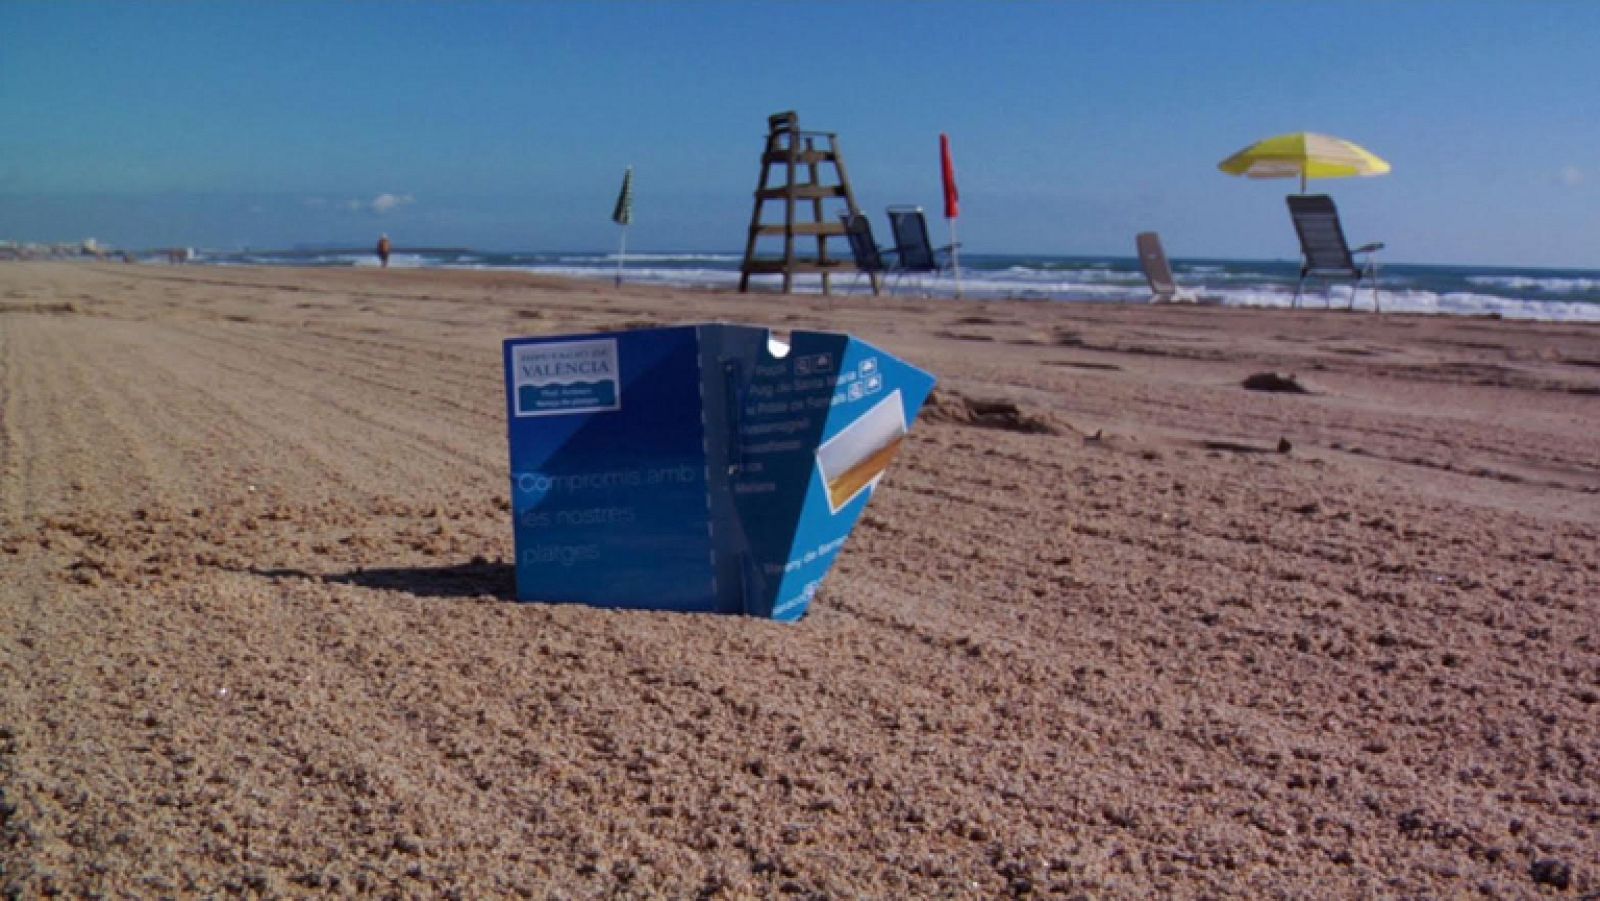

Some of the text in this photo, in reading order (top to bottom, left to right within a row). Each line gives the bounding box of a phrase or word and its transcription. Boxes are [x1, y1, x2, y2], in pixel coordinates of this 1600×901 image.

[647, 462, 697, 485] amb
[520, 506, 636, 528] les nostres
